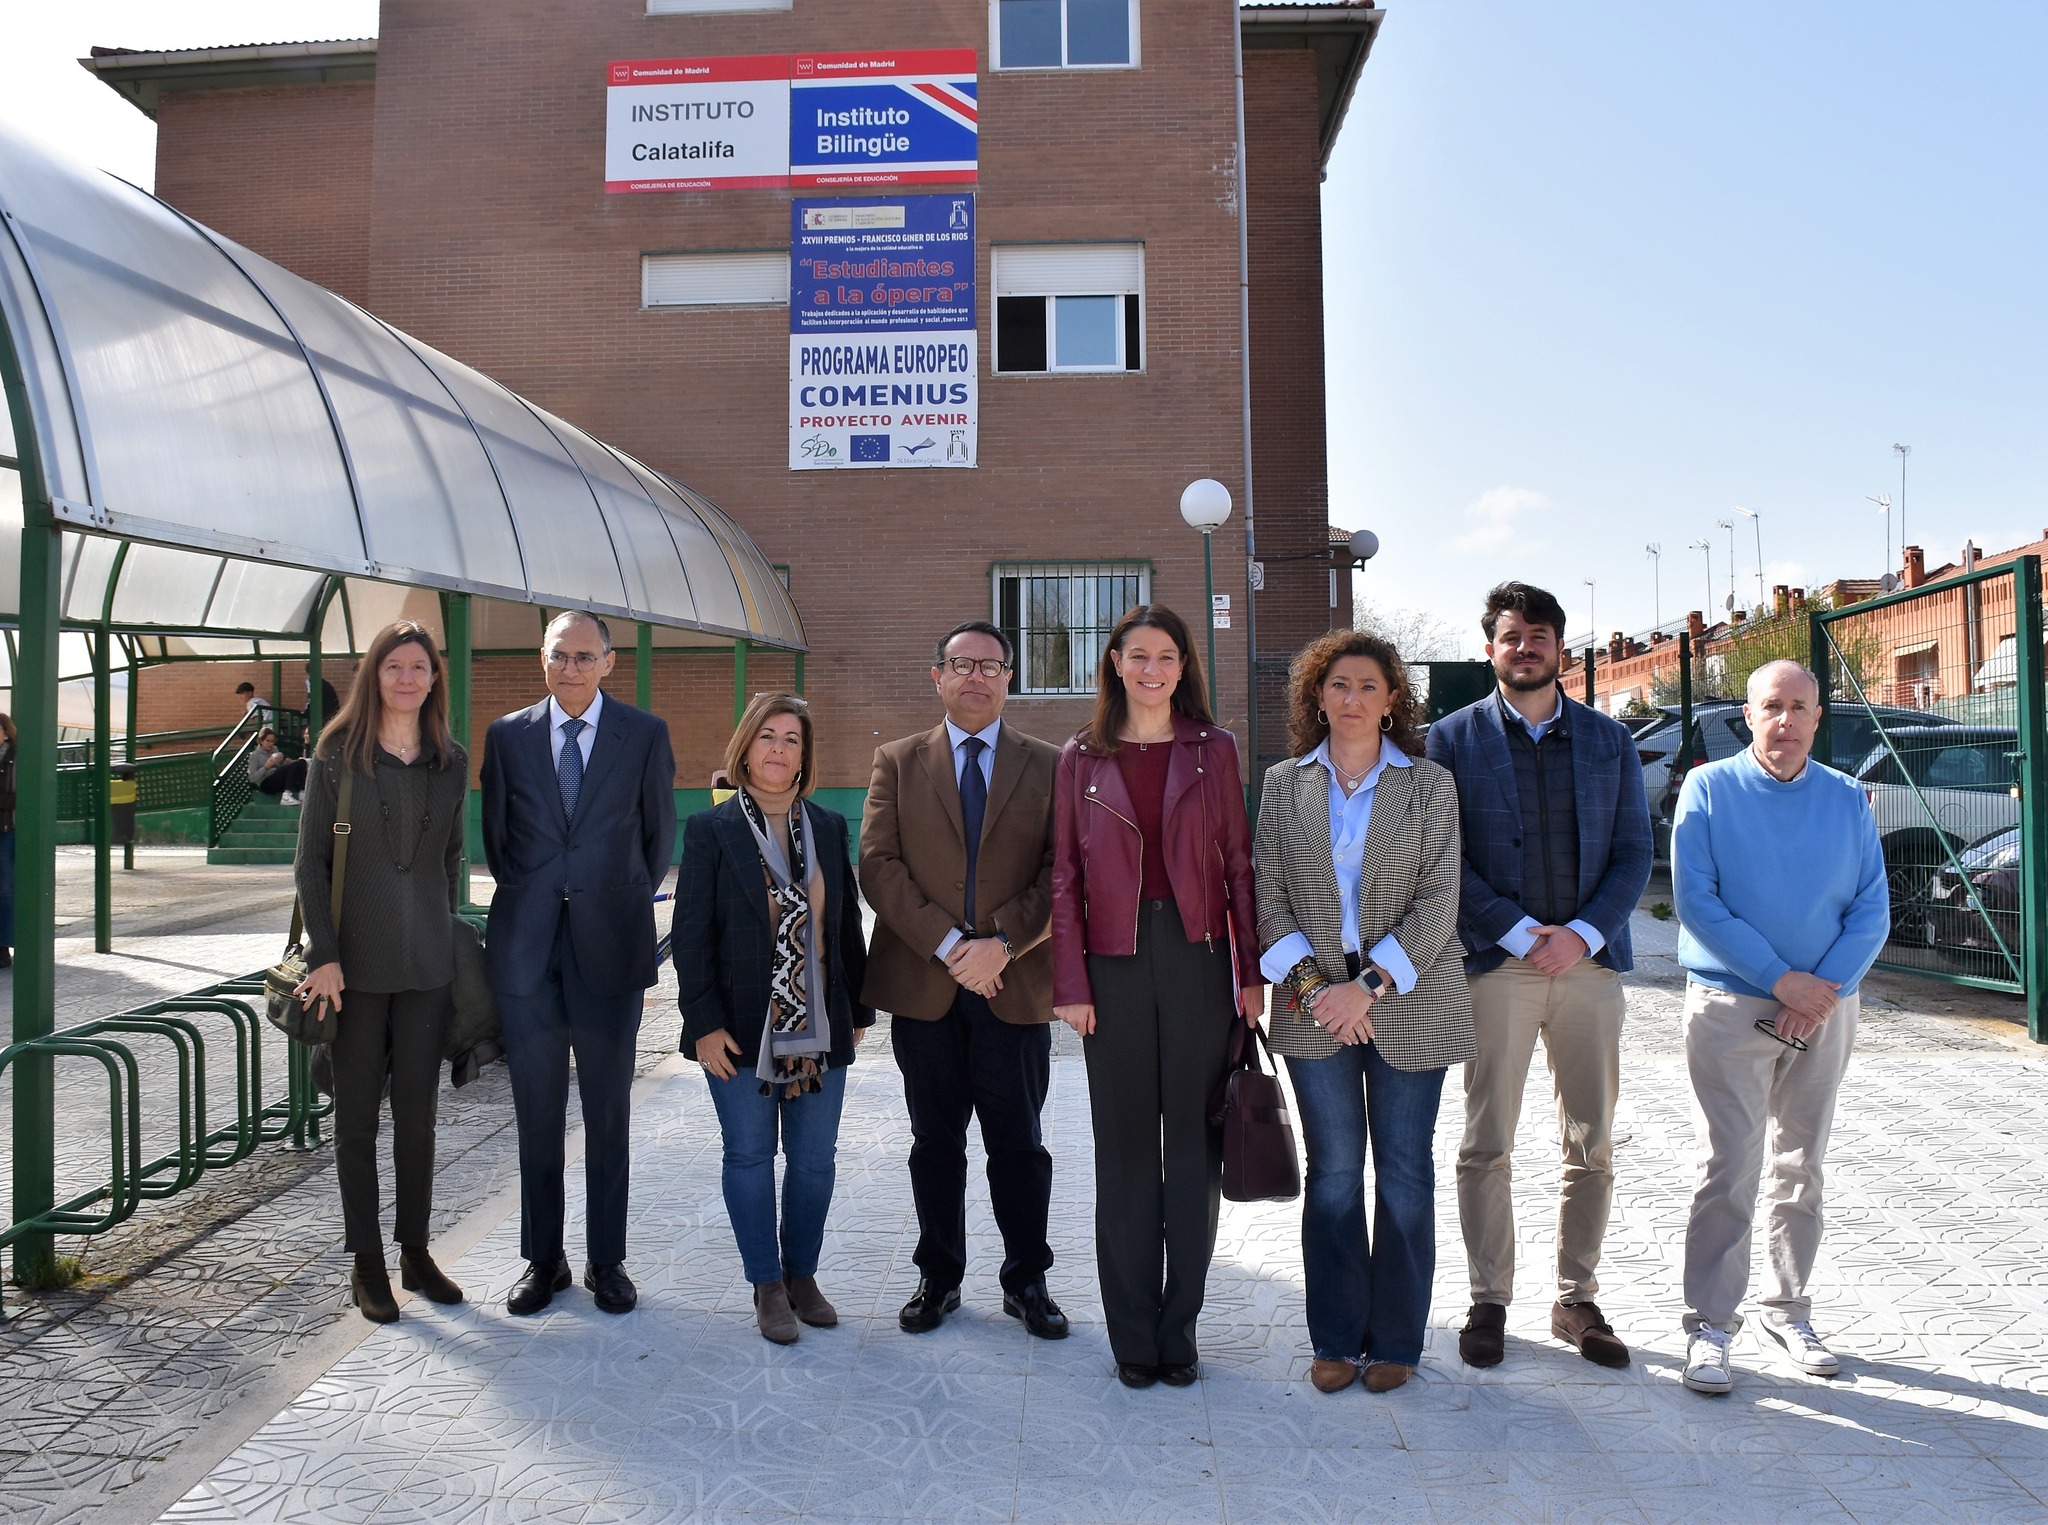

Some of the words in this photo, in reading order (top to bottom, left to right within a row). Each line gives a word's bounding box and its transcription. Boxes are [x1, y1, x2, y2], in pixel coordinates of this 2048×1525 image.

[633, 68, 672, 77] Comunidad
[632, 100, 754, 122] INSTITUTO
[817, 107, 910, 127] Instituto
[632, 140, 735, 161] Calatalifa
[817, 133, 910, 157] Bilingüe
[802, 236, 823, 244] XXVIII
[824, 235, 856, 244] PREMIOS
[862, 234, 901, 243] FRANCISCO
[903, 233, 924, 242] GINER
[925, 233, 935, 241] DE
[936, 233, 950, 241] LOS
[952, 232, 968, 241] RIOS
[814, 290, 830, 304] a
[838, 286, 863, 304] la
[801, 345, 890, 376] PROGRAMA
[894, 344, 968, 374] EUROPEO
[800, 383, 968, 407] COMENIUS
[800, 414, 892, 428] PROYECTO
[901, 413, 968, 426] AVENIR
